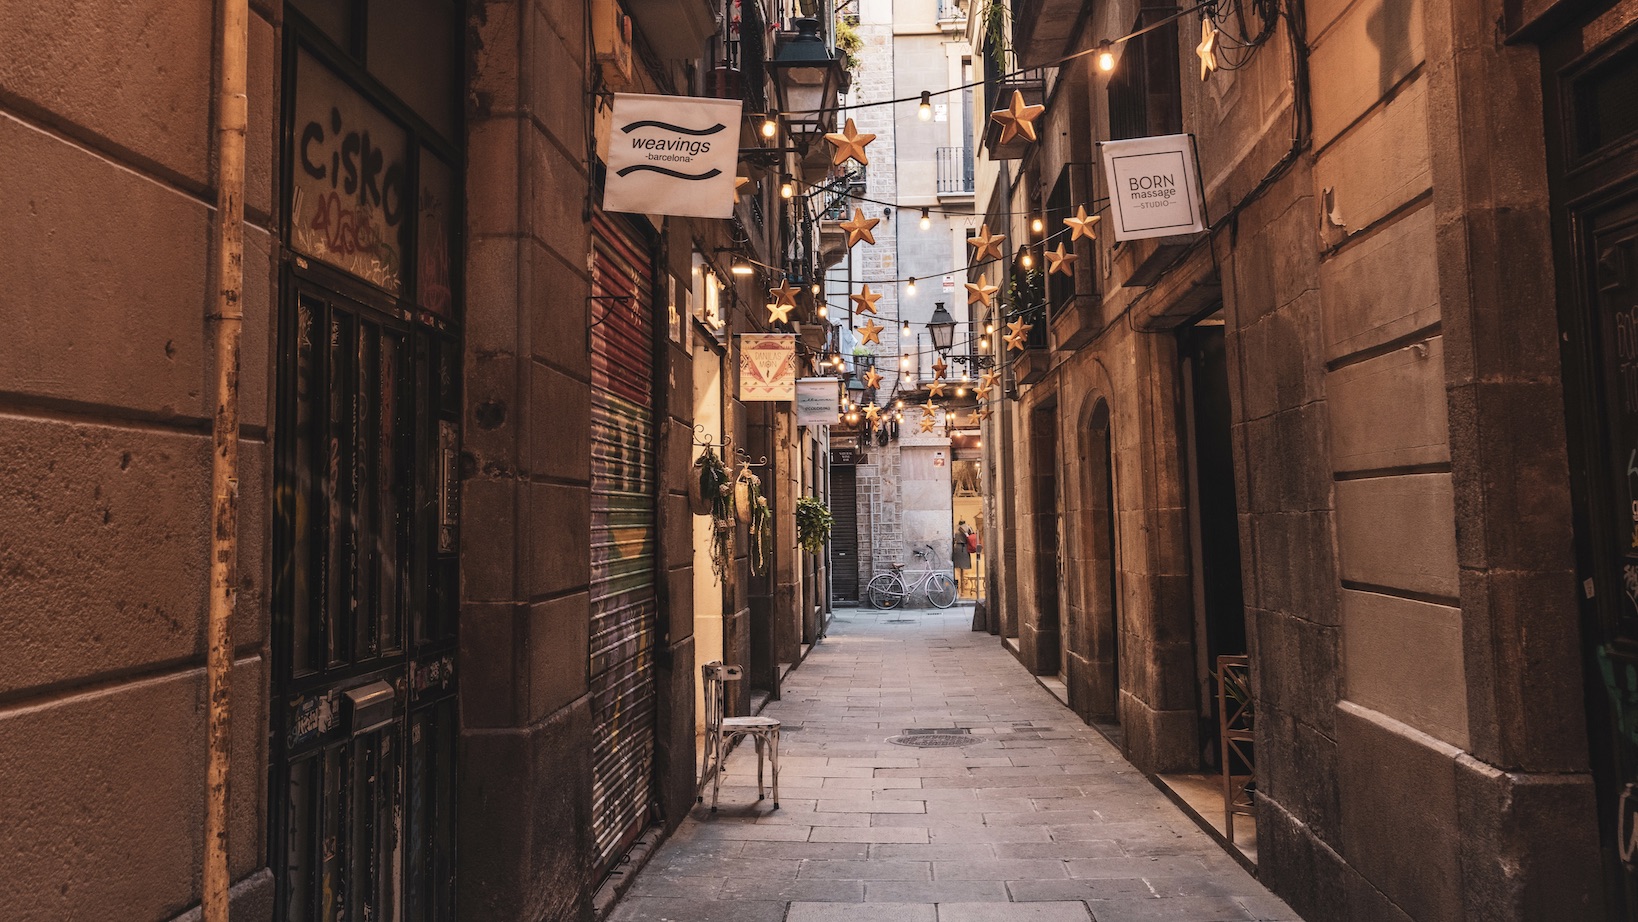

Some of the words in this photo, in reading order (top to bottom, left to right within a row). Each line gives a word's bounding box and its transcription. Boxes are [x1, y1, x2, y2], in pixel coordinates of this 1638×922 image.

[632, 137, 711, 156] weavings
[645, 152, 694, 163] -barcelona-
[1129, 173, 1175, 191] BORN
[1131, 188, 1176, 199] massage
